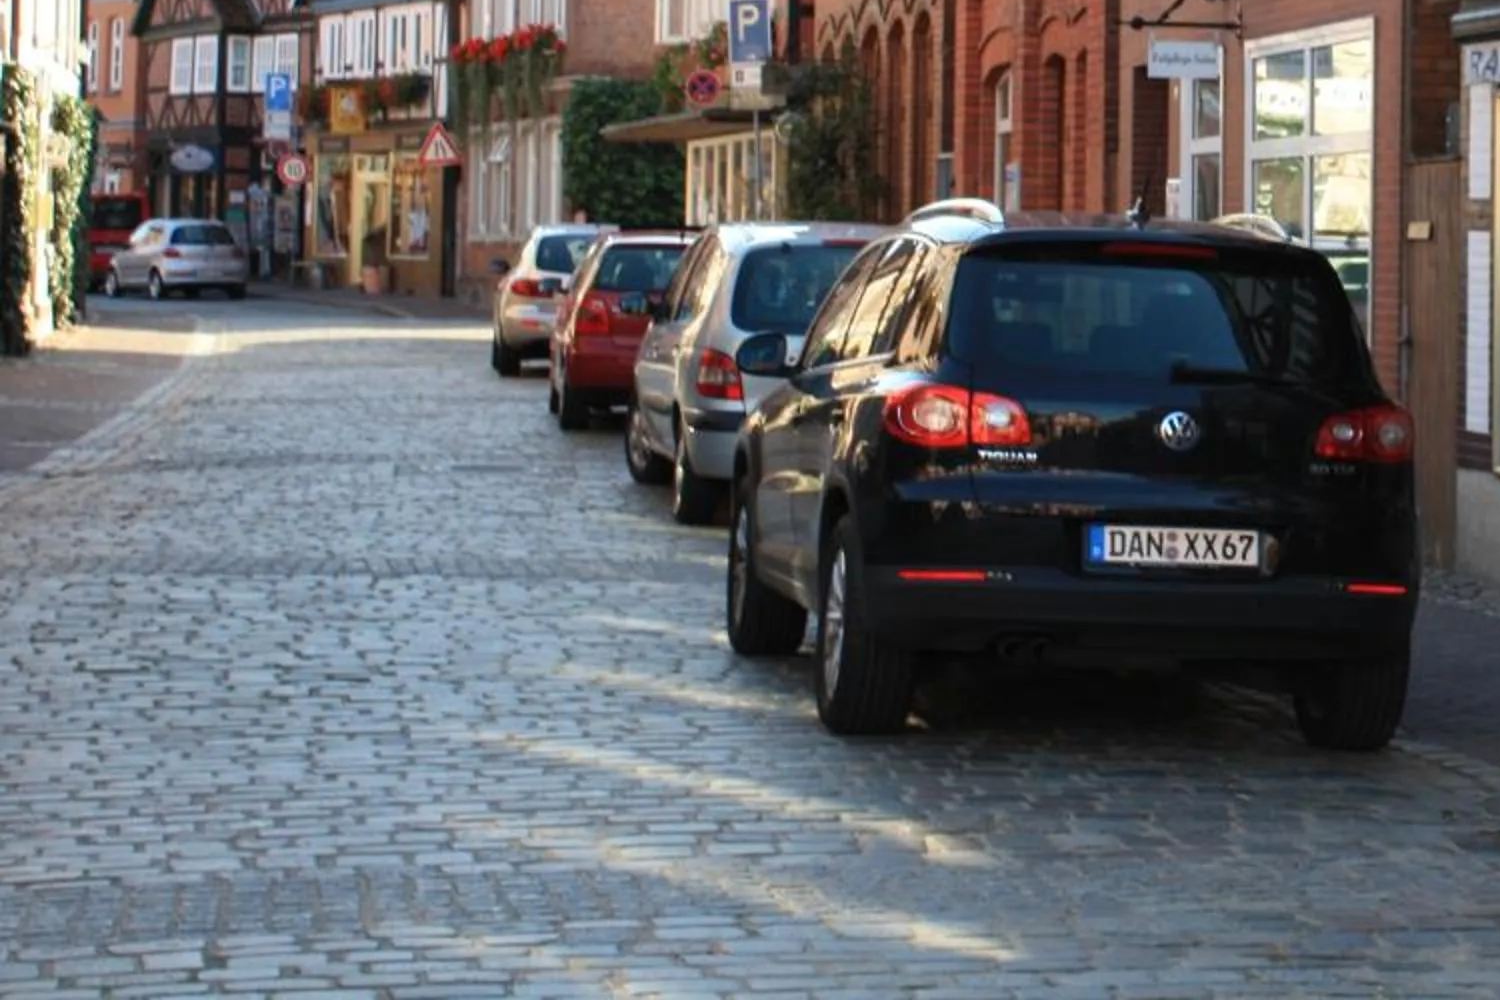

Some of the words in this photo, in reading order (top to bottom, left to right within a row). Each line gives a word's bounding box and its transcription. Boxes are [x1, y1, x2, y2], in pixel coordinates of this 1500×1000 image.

[738, 5, 759, 42] P
[270, 78, 286, 98] P
[1109, 530, 1164, 557] DAN
